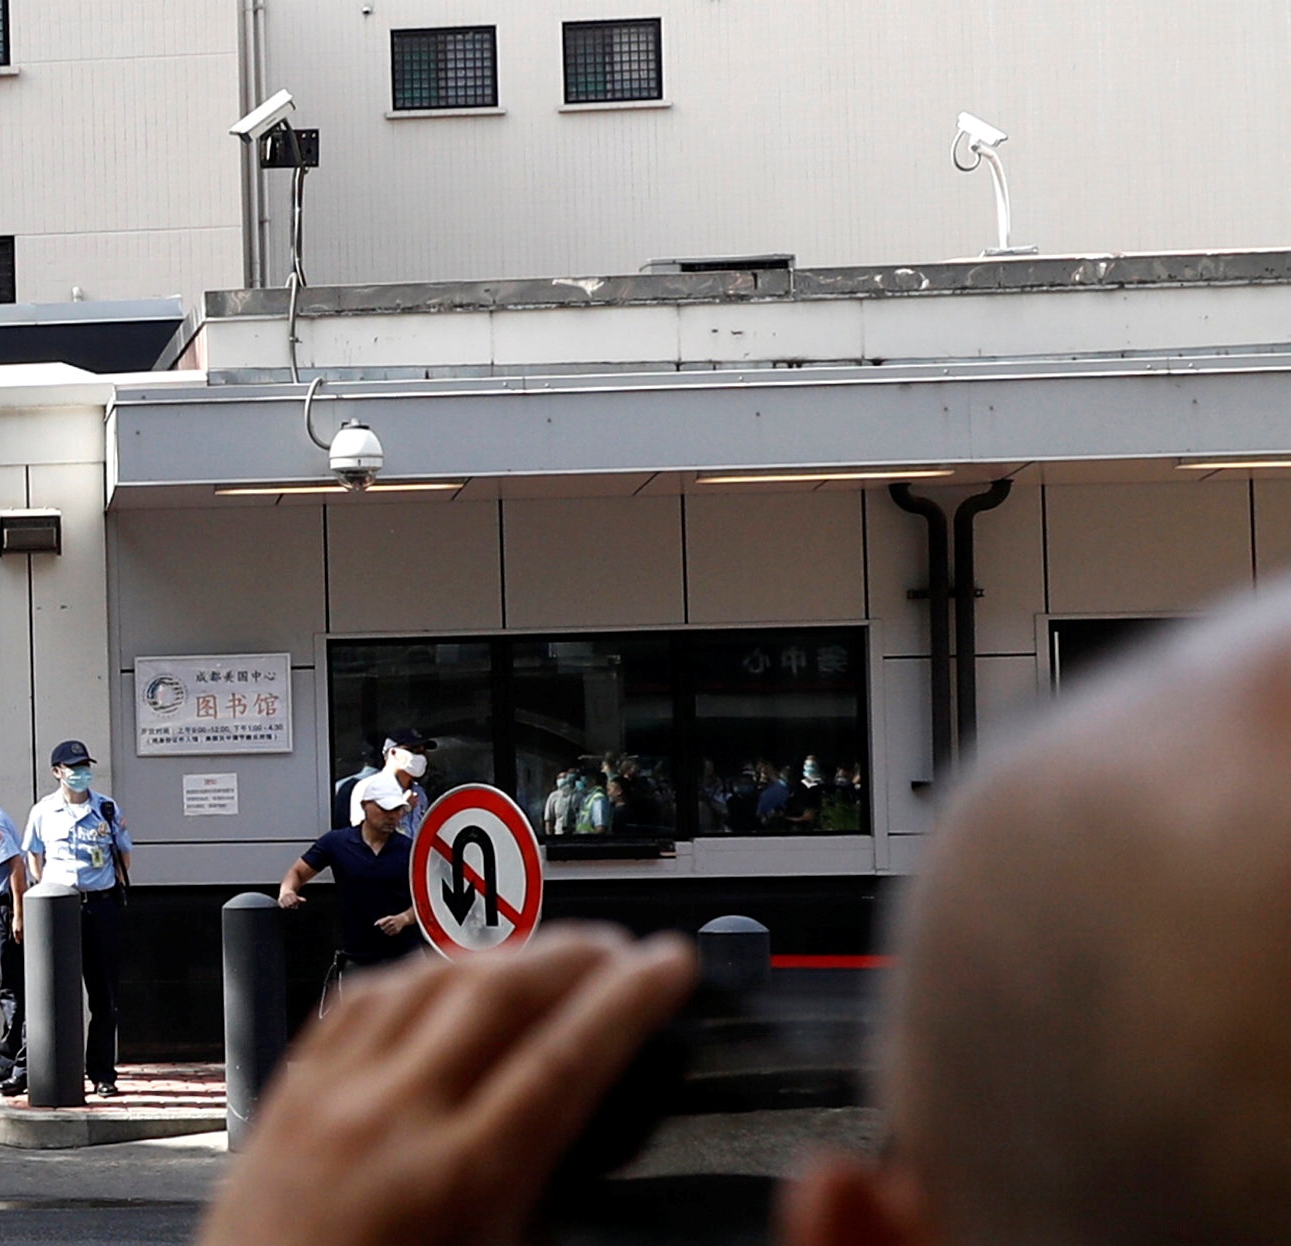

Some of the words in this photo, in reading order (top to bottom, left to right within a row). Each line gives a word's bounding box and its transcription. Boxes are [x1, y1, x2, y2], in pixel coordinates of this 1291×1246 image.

[196, 669, 276, 683] 成都美国中心
[196, 692, 279, 719] 图书馆
